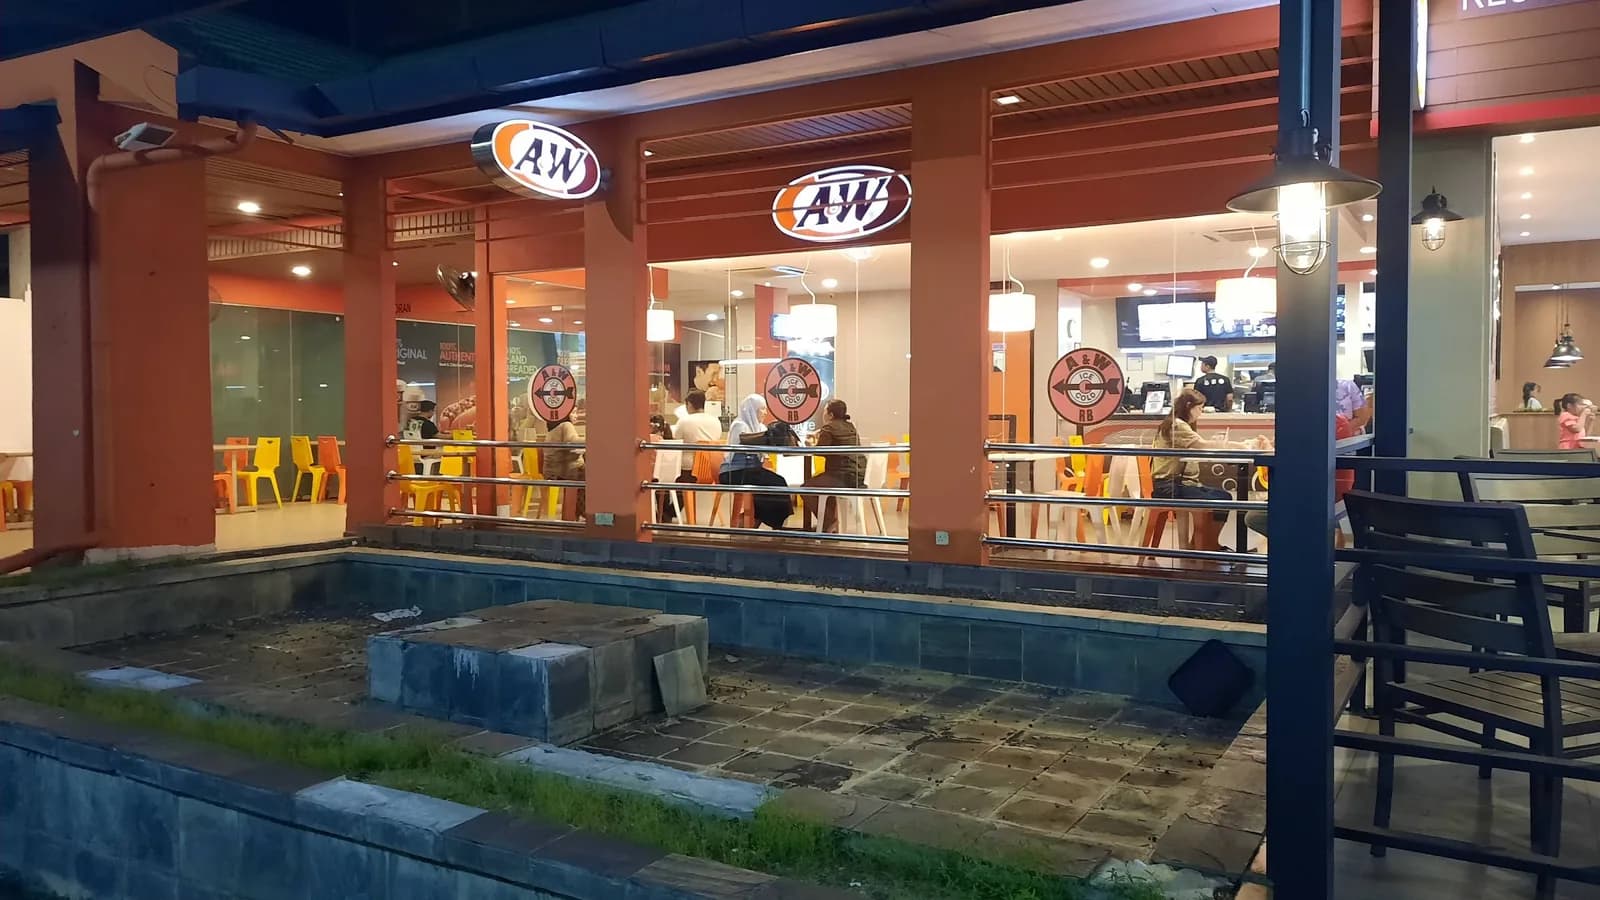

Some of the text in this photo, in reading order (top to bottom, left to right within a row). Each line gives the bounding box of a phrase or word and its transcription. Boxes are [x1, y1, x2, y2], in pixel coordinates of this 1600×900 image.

[514, 137, 585, 184] AW
[1079, 372, 1095, 380] ICE
[787, 378, 798, 386] ICE
[784, 396, 801, 404] COLD
[1075, 393, 1096, 402] COLD
[1079, 409, 1094, 422] RB
